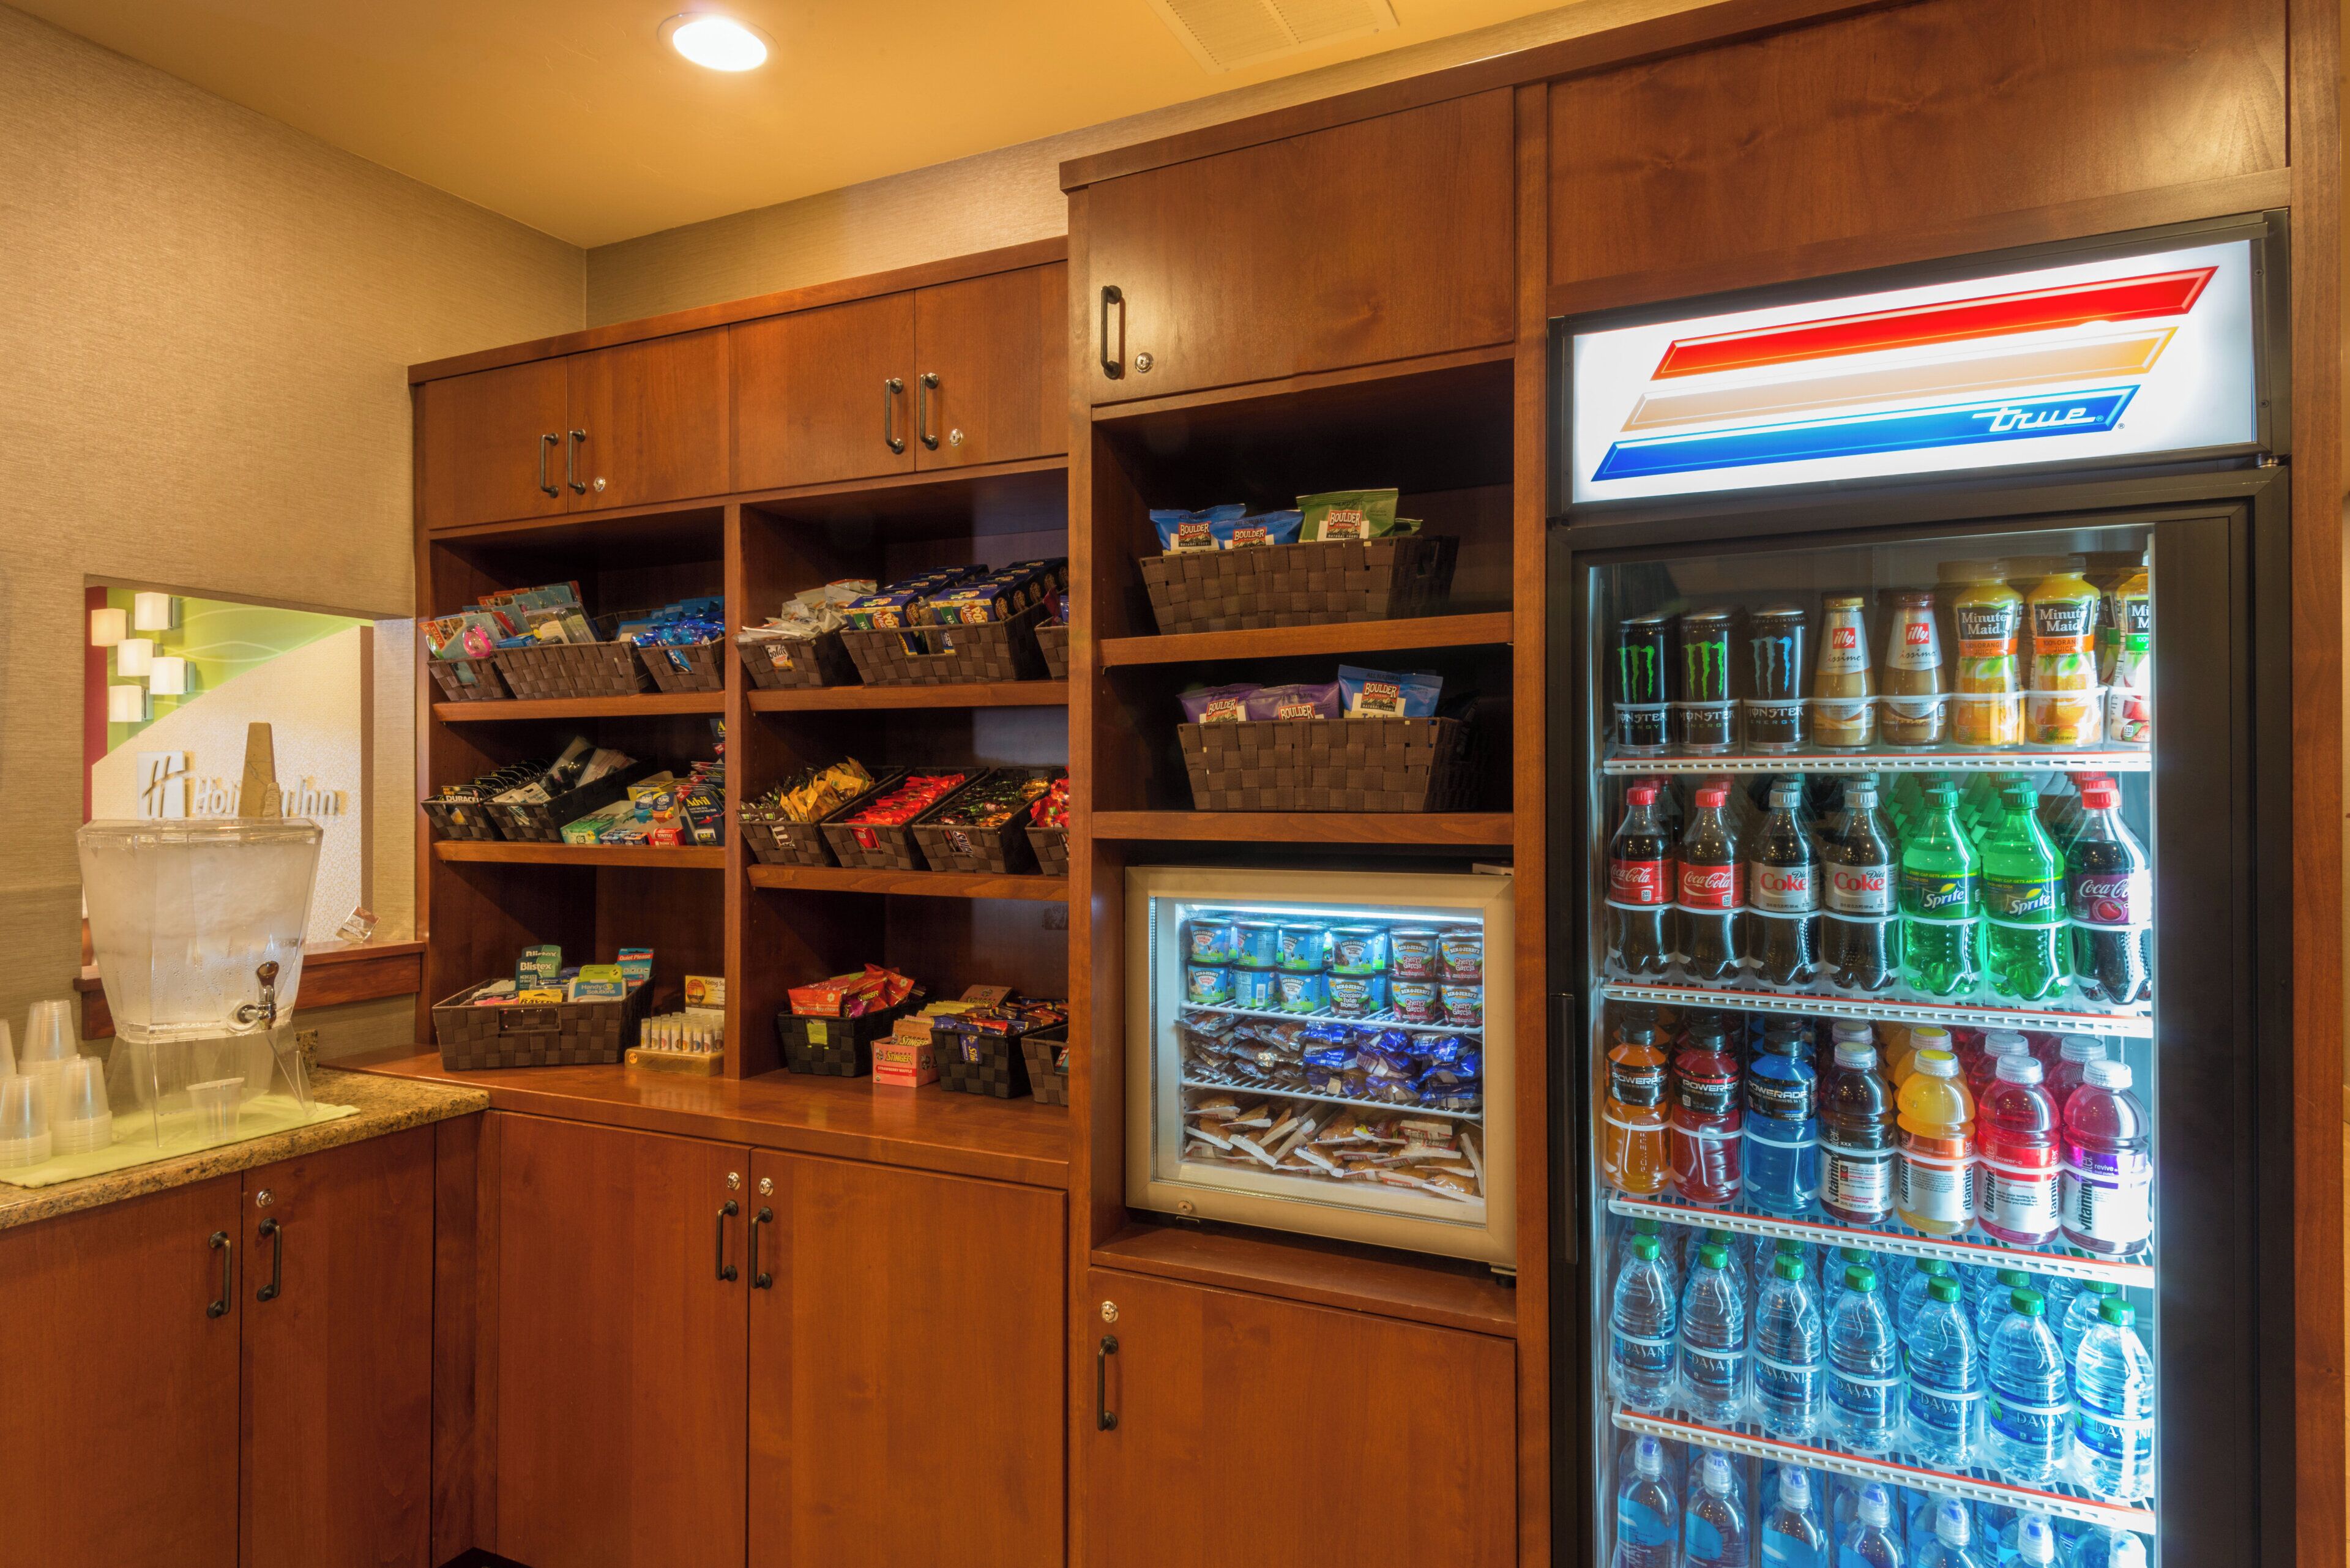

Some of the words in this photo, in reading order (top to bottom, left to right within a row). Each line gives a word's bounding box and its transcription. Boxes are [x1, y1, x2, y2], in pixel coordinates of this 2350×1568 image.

[1972, 408, 2095, 432] true
[1330, 512, 1360, 526] BOULDER
[1180, 523, 1210, 536] BOULDER
[1234, 529, 1265, 541] BOULDER
[1961, 612, 2007, 624] Minute
[2046, 620, 2080, 632] Maid
[1908, 626, 1929, 643] illy
[1968, 623, 2001, 636] Maid
[1834, 630, 1855, 647] illy
[1826, 652, 1863, 663] issimo
[1899, 649, 1938, 659] issimo
[1364, 682, 1397, 698] BOULDER
[1208, 700, 1236, 716] BOULDER
[1280, 704, 1314, 720] BOULDER
[293, 774, 338, 816] Inn
[685, 796, 711, 807] Advil
[1611, 865, 1654, 884] Coca-Cola
[1684, 870, 1733, 889] Coca-Cola
[1760, 872, 1810, 891] Coke
[1833, 872, 1885, 891] Coke
[1923, 887, 1964, 909] Sprite
[2009, 892, 2051, 916] Sprite
[520, 962, 552, 972] Blistex
[886, 1051, 912, 1065] STINGER
[1996, 1155, 2023, 1165] power-c
[2094, 1163, 2114, 1172] revive
[1624, 1341, 1669, 1358] DASANI
[1692, 1353, 1737, 1372] DASANI
[1758, 1360, 1805, 1384] DASANI
[1836, 1378, 1886, 1398] DASAN
[2095, 1421, 2150, 1443] DASNI
